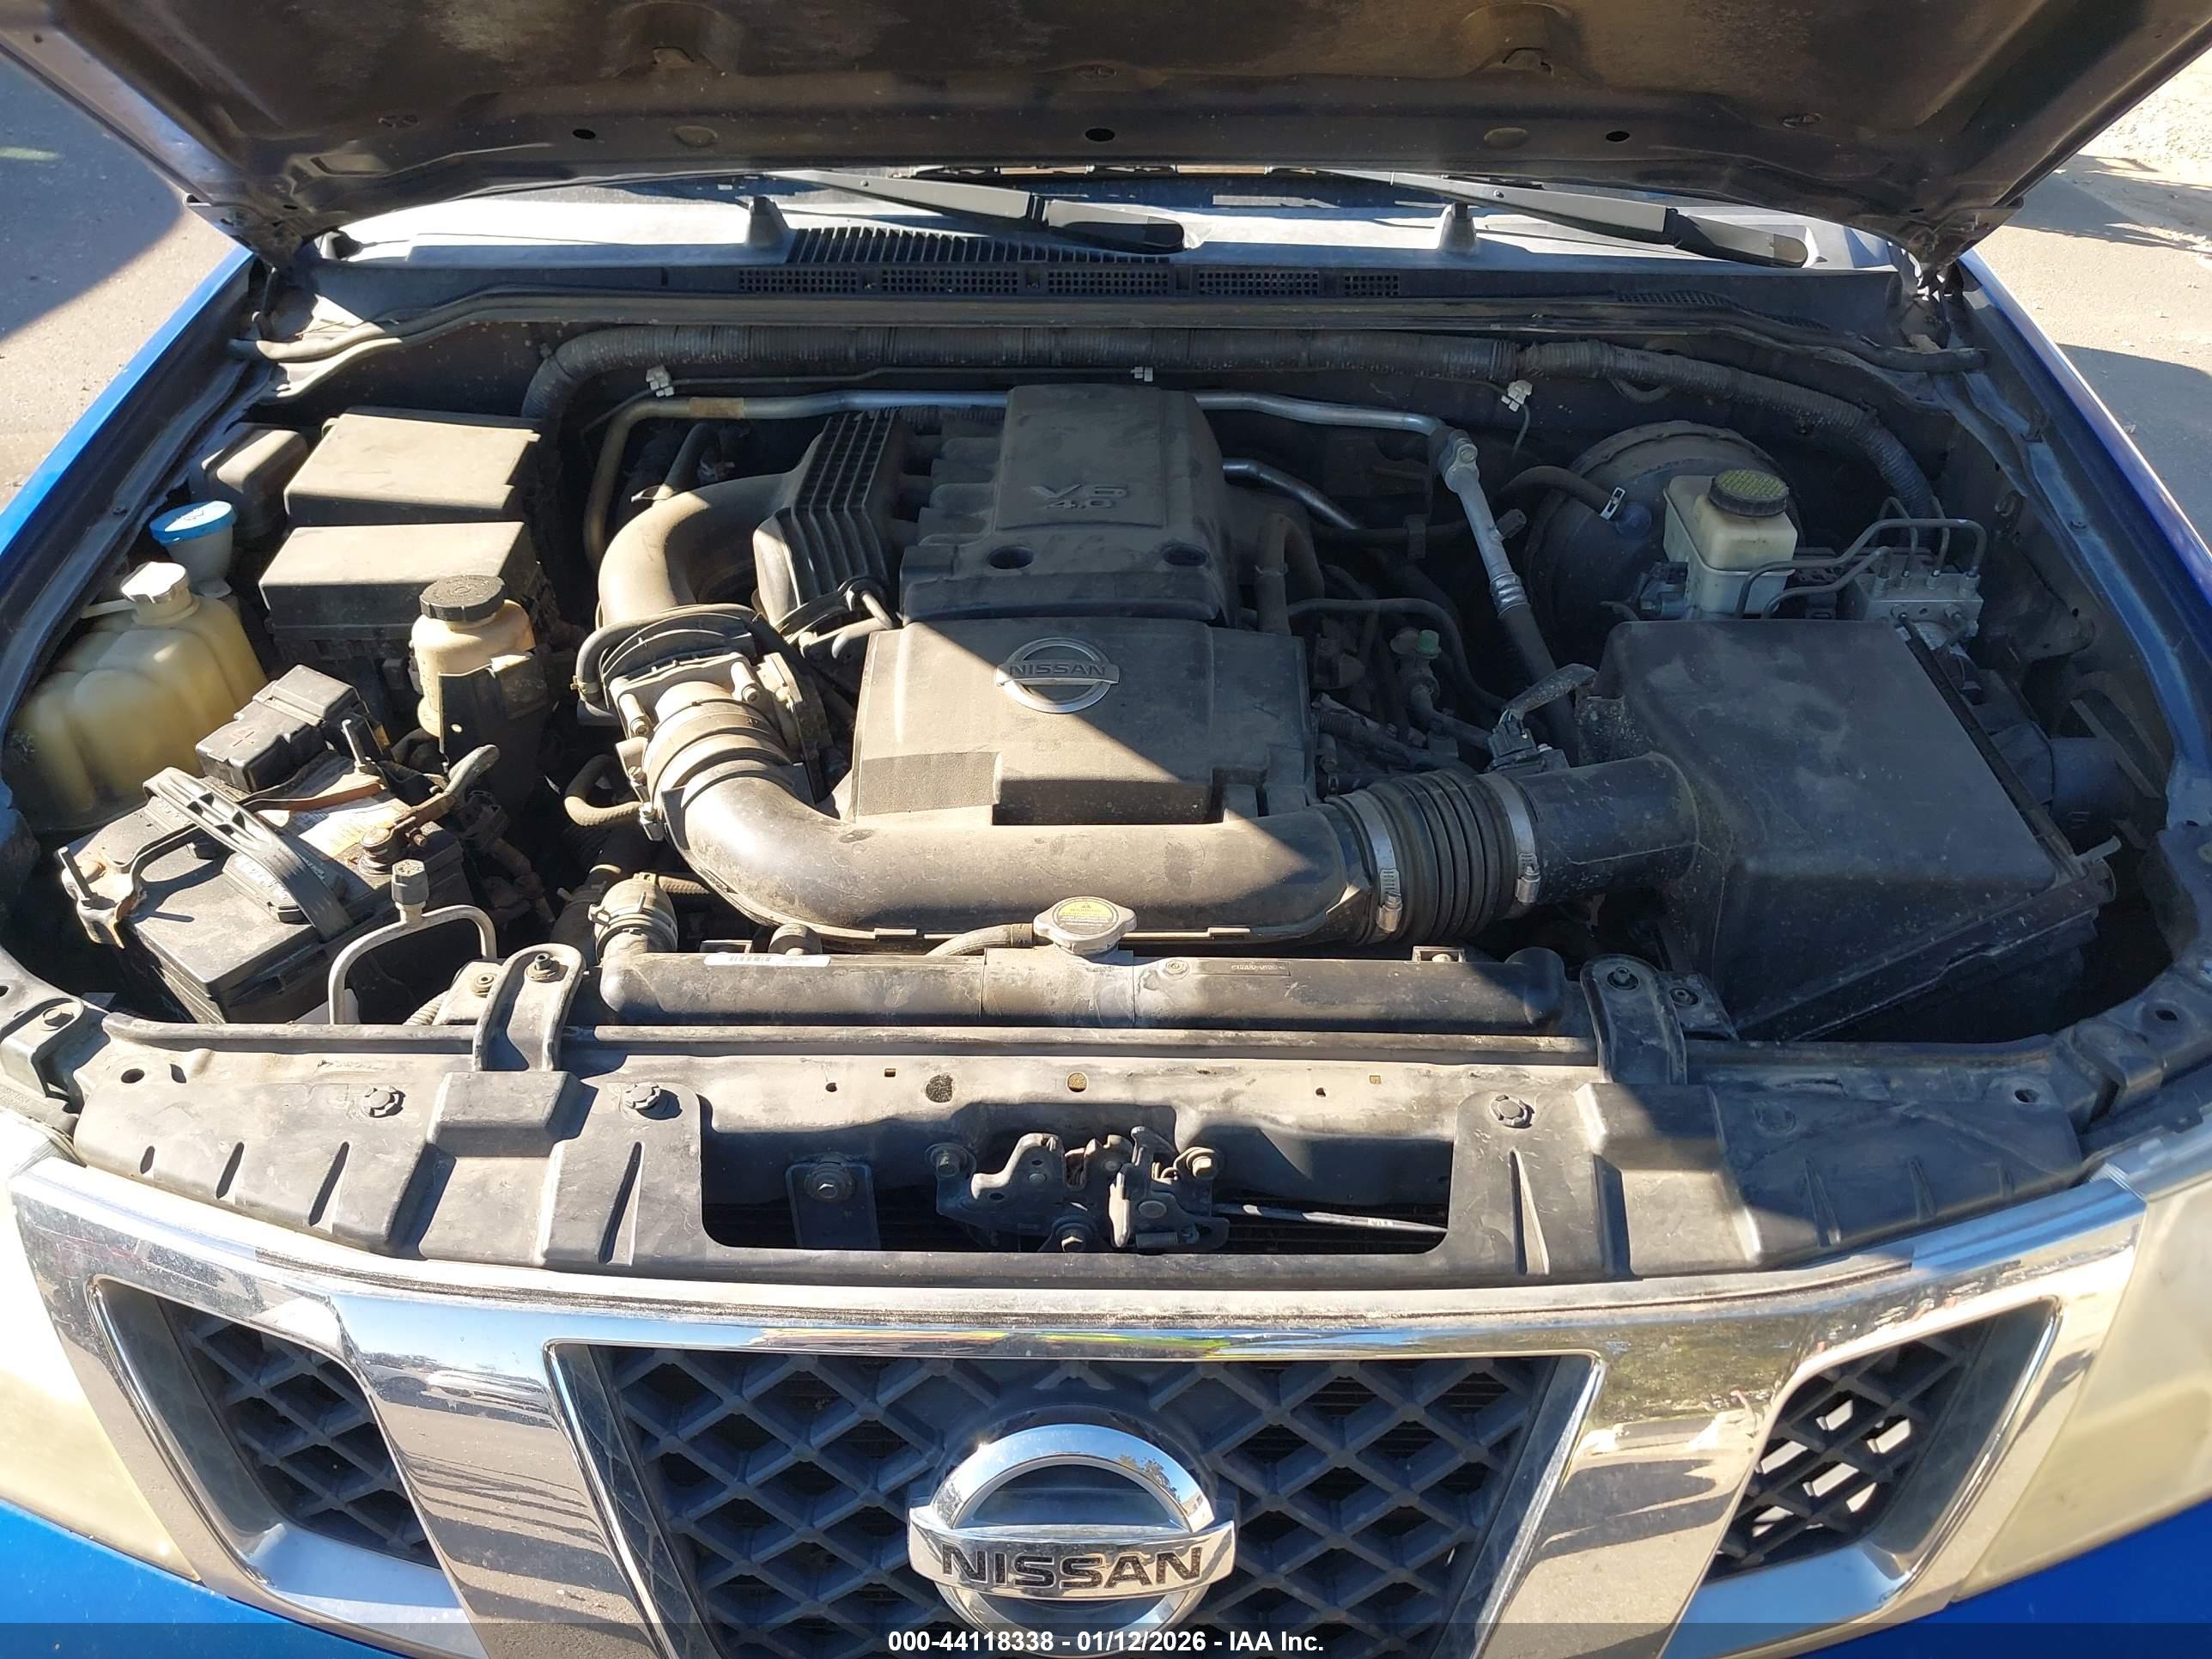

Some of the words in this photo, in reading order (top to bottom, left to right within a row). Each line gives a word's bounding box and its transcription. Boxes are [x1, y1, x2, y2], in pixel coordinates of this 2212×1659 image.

[1030, 483, 1127, 498] V6
[1046, 499, 1112, 508] 4.0
[1009, 663, 1106, 676] NISSAN
[941, 1544, 1202, 1589] NISSAN
